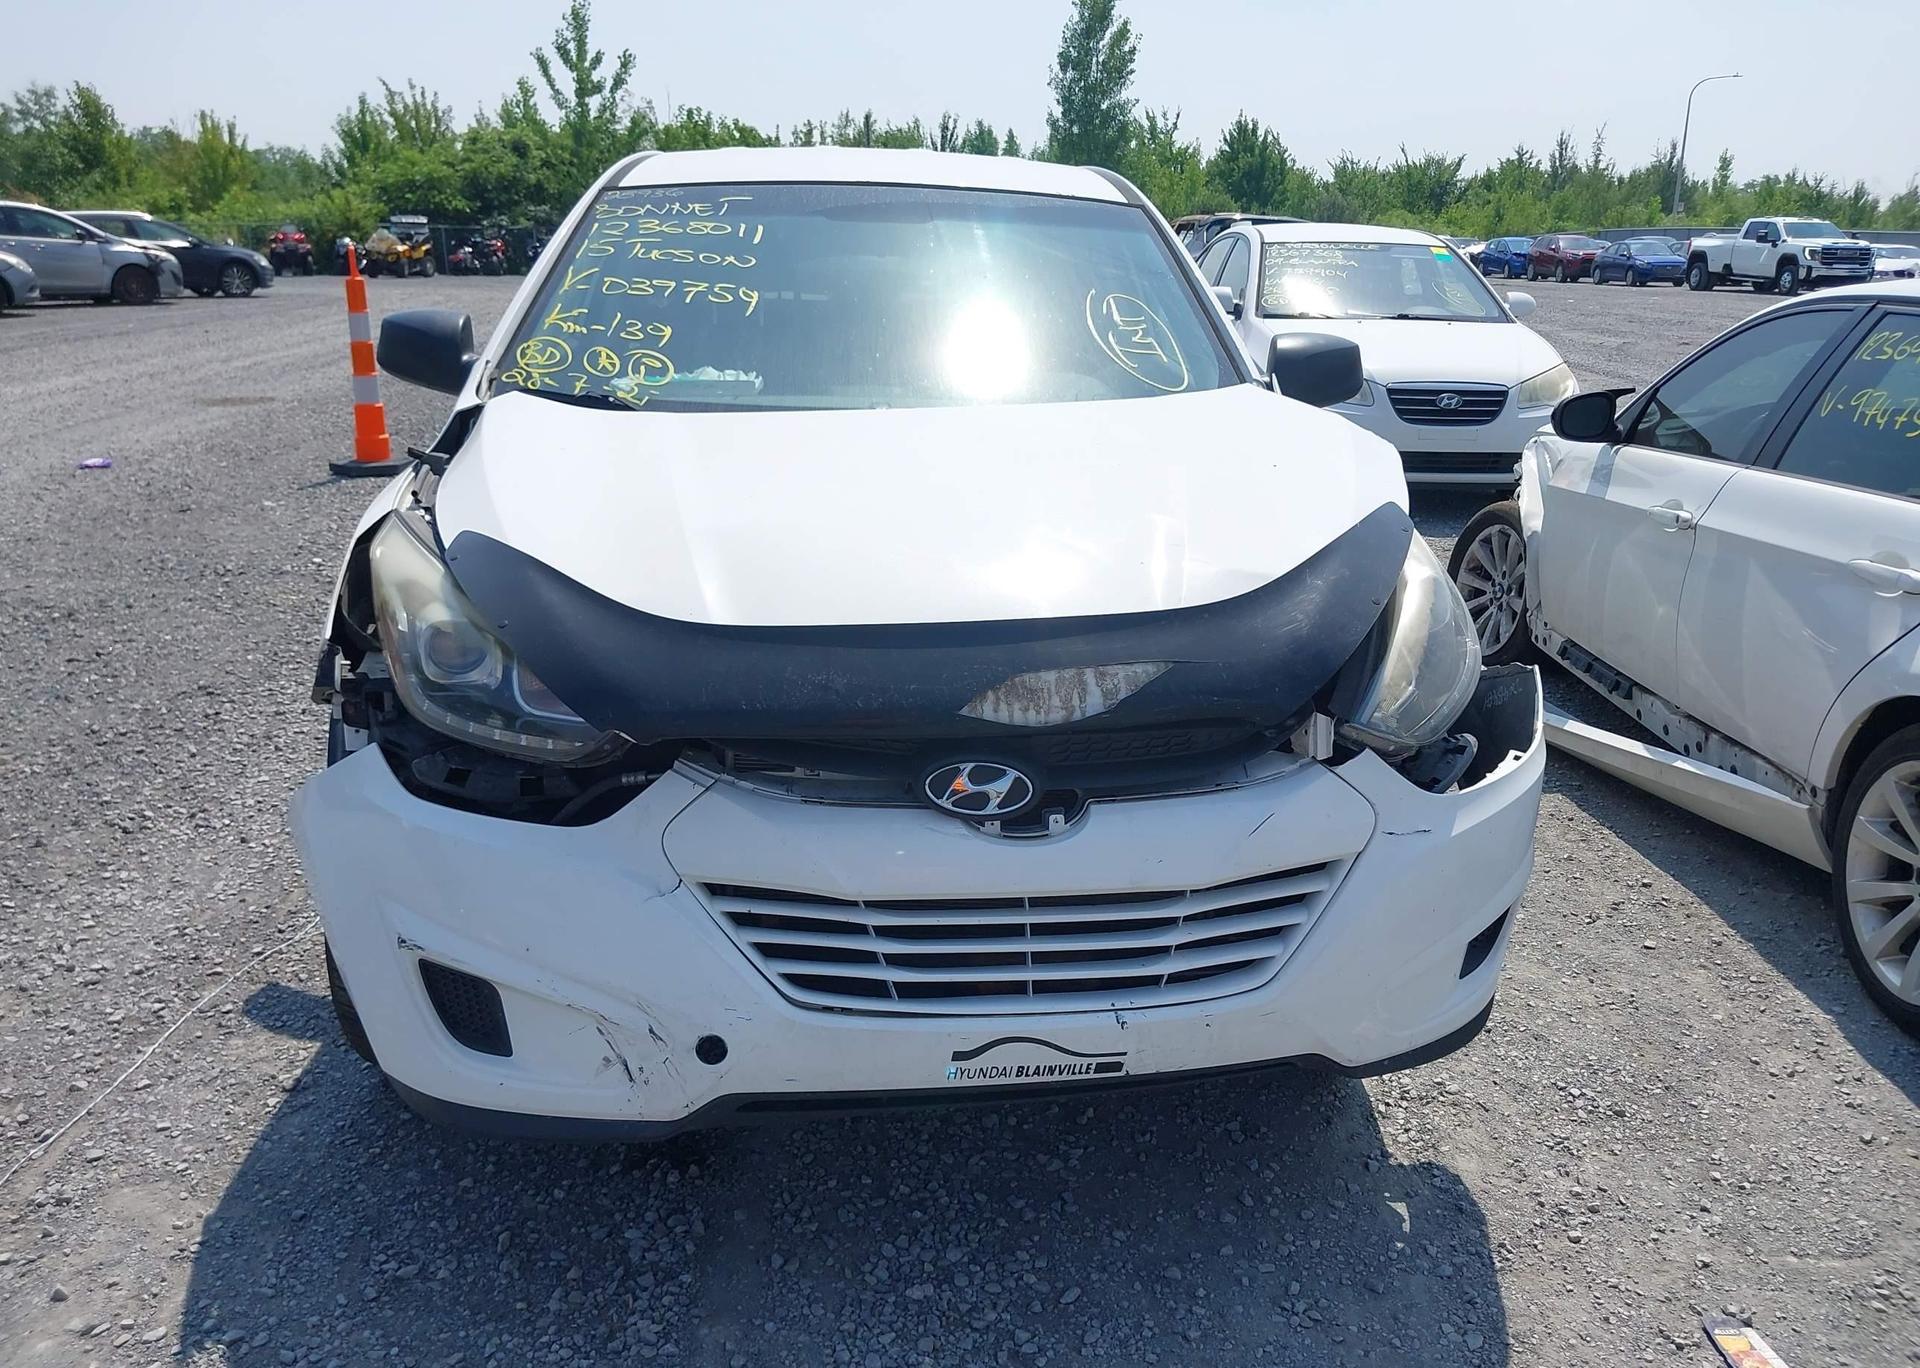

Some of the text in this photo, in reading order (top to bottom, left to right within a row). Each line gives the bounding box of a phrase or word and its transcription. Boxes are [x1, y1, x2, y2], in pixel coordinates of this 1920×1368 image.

[595, 196, 752, 219] BONNET
[576, 238, 624, 259] 15
[946, 1062, 1094, 1081] HYUNDAI BLAINVILLE
